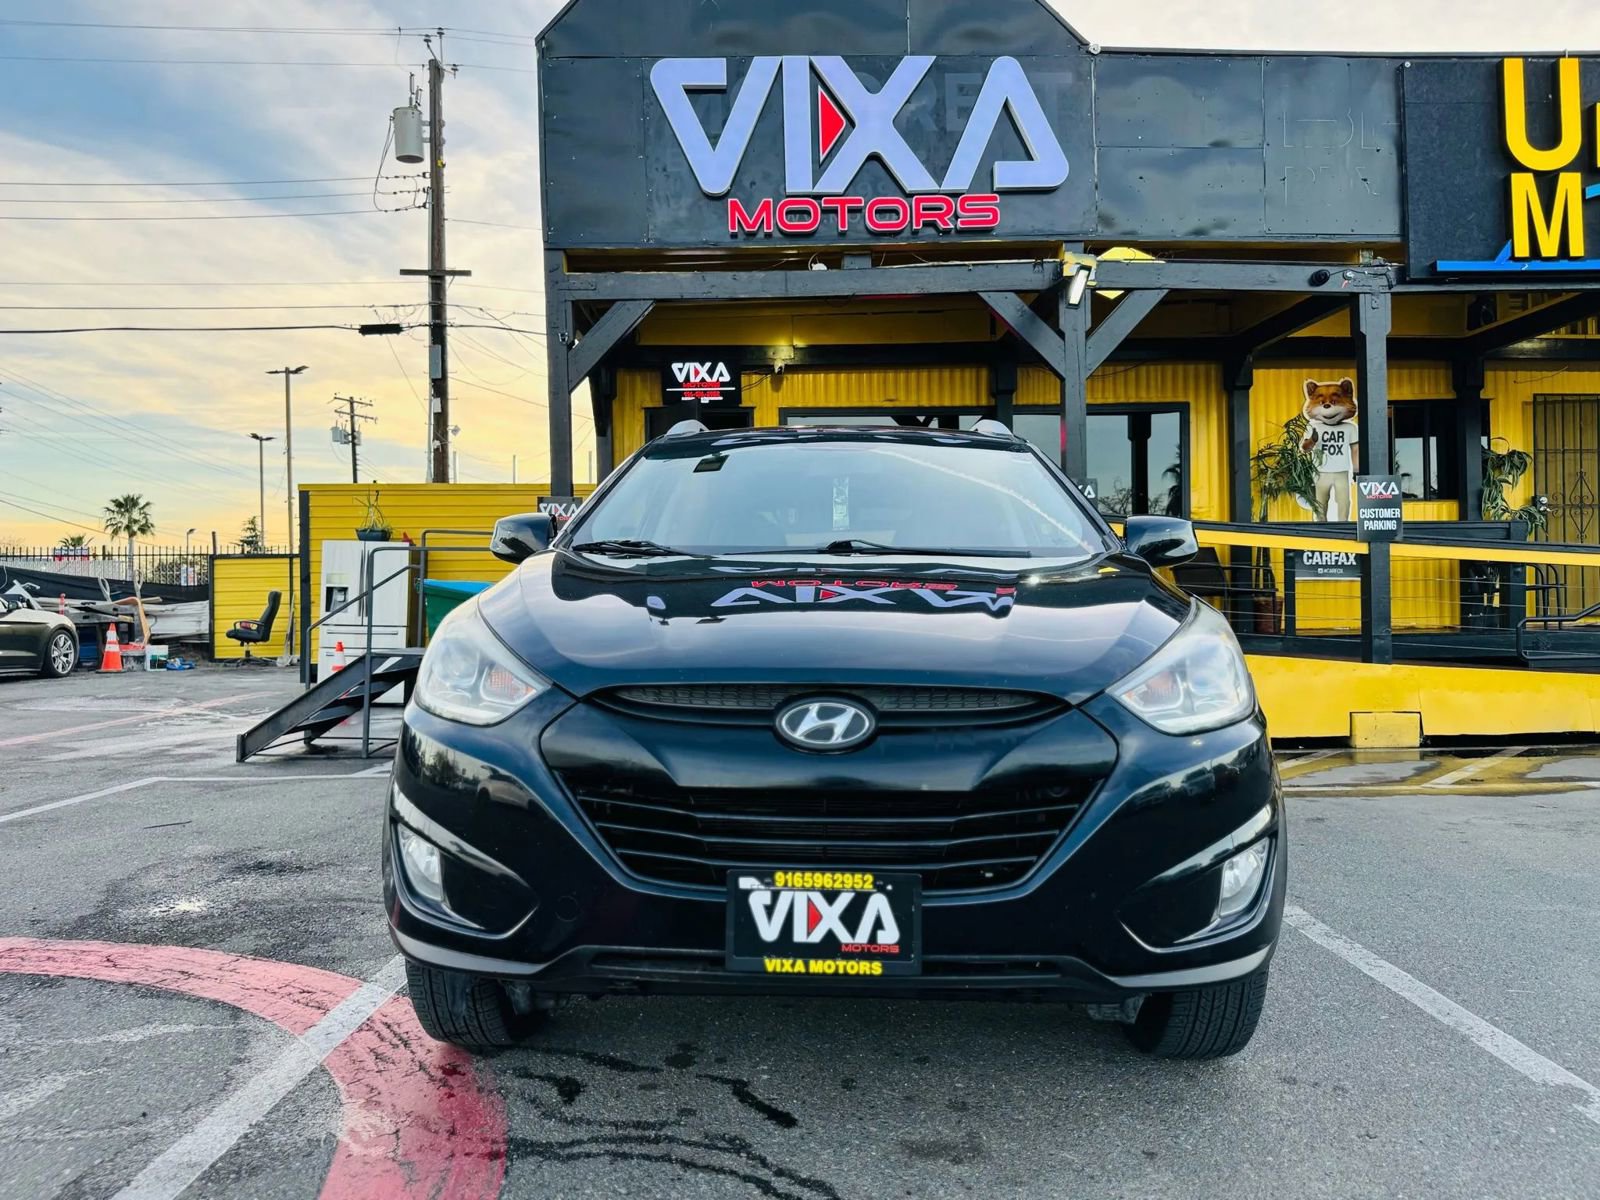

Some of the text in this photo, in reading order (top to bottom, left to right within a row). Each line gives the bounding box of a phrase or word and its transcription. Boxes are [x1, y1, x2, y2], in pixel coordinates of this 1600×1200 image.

[650, 56, 1070, 195] VIXA
[728, 194, 1001, 234] MOTORS
[671, 361, 731, 383] VIXA
[1321, 431, 1345, 443] CAR
[1322, 444, 1344, 456] FOX
[1359, 482, 1399, 495] VIXA
[1359, 508, 1400, 519] CUSTOMER
[1364, 520, 1397, 531] PARKING
[1303, 551, 1357, 566] CARFAX
[774, 871, 874, 889] 9165962952
[748, 891, 900, 944] VIXA
[841, 943, 899, 953] MOTORS
[764, 958, 882, 975] VIXA MOTORS
